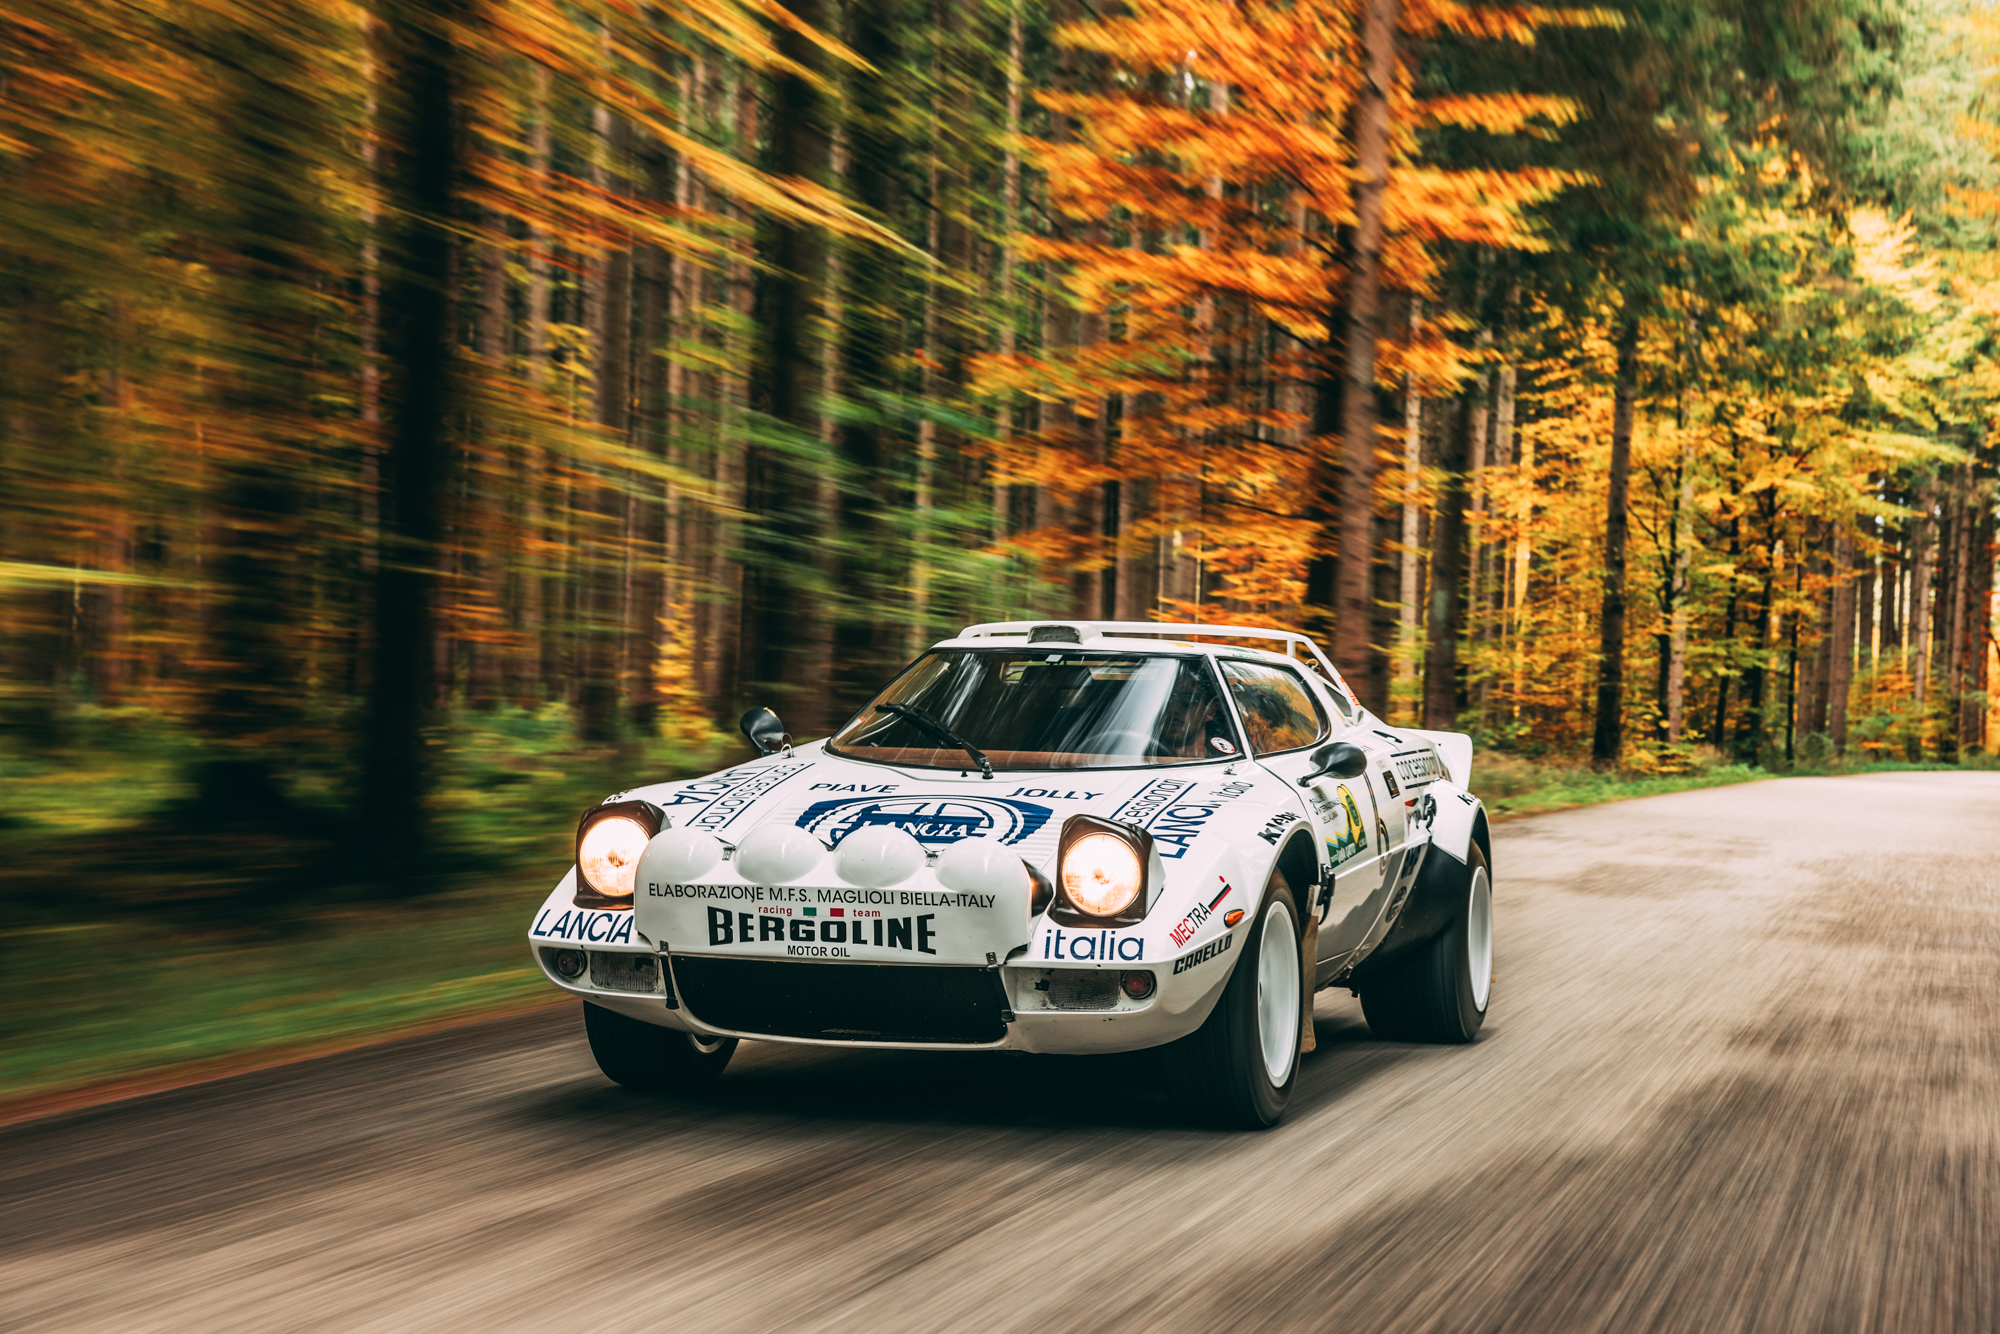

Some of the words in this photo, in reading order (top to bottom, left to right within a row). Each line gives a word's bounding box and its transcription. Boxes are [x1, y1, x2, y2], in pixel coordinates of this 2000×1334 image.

[808, 783, 900, 794] PIAVE
[1006, 787, 1104, 800] JOLLY
[648, 882, 765, 901] ELABORAZIONE
[769, 887, 811, 902] M.F.S.
[817, 889, 895, 905] MAGLIOLI
[900, 892, 996, 908] BIELLA-ITALY
[533, 908, 635, 944] LANCIA
[758, 905, 793, 917] racing
[853, 908, 881, 918] team
[1169, 901, 1212, 948] MECTRA
[707, 905, 937, 955] BERGOLINE
[787, 944, 828, 957] MOTOR
[831, 945, 851, 958] OIL
[1044, 929, 1144, 961] italia
[1172, 933, 1233, 976] CARELLO
